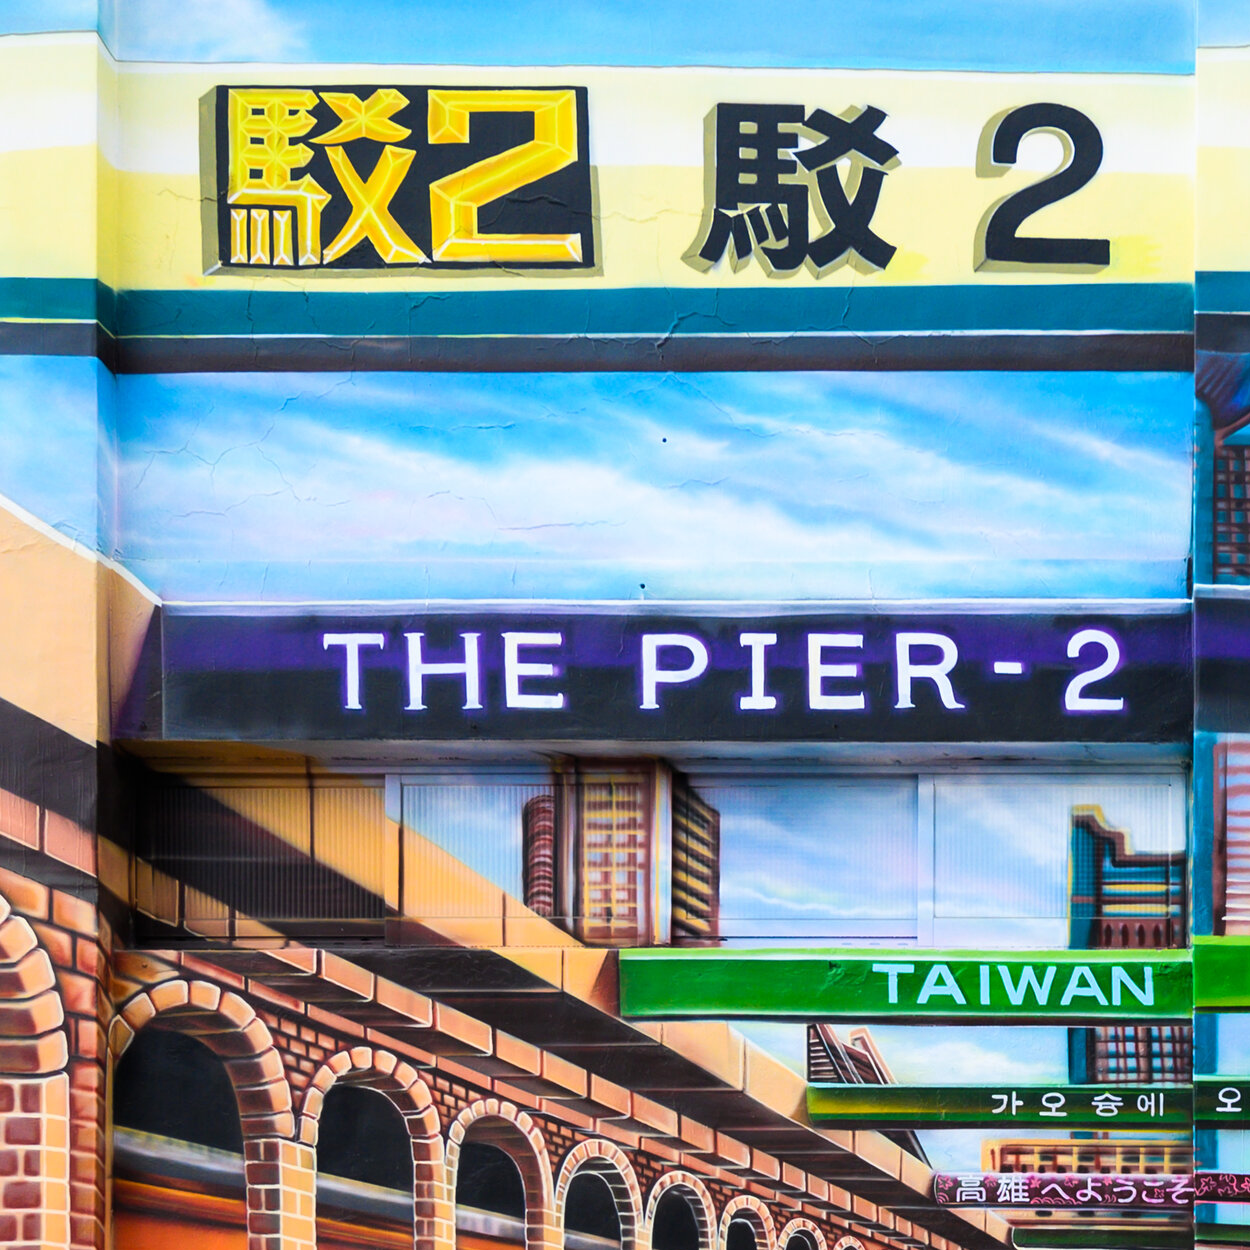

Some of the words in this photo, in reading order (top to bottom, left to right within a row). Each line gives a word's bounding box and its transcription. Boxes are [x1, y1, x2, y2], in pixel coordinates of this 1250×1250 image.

[228, 88, 583, 265] 駁2
[323, 631, 564, 710] THE
[871, 962, 1155, 1008] TAIWAN
[956, 1175, 1194, 1204] 高雄へようこそ
